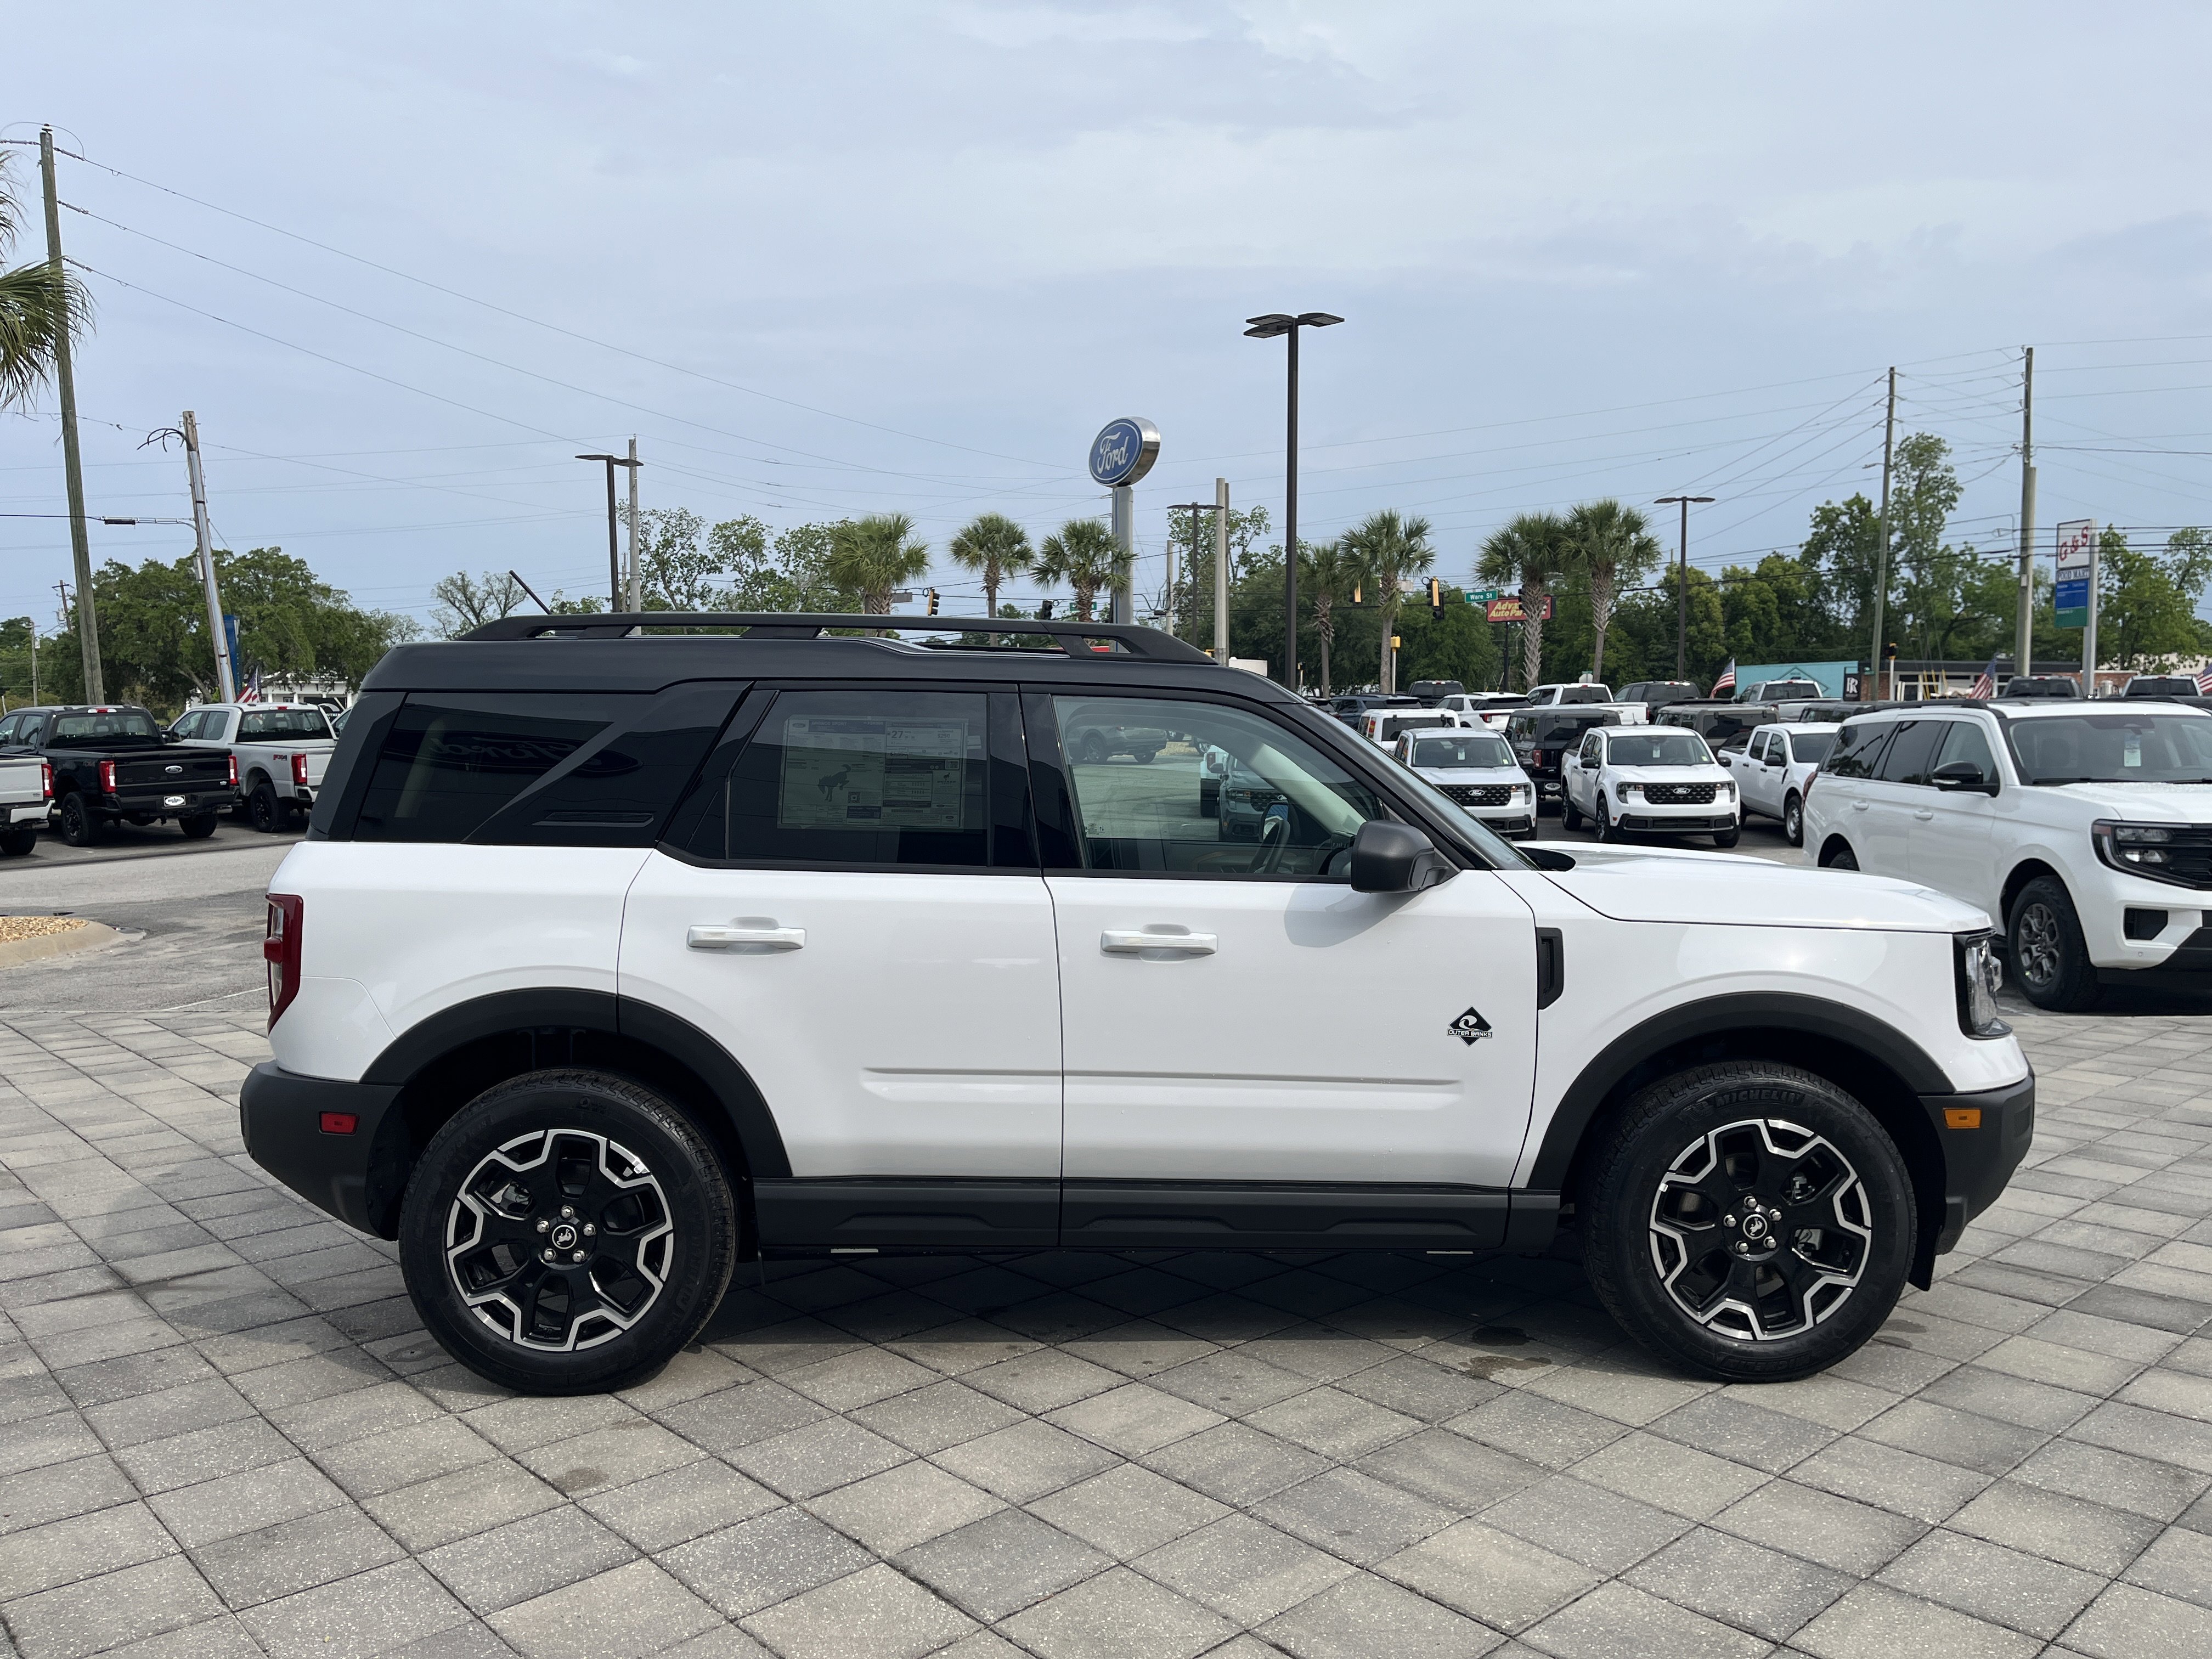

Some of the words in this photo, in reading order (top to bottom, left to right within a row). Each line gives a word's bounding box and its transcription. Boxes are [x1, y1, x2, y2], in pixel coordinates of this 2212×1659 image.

[1097, 432, 1130, 474] Ford
[2081, 526, 2089, 546] S
[2073, 568, 2089, 578] MART
[891, 730, 903, 738] 27
[1716, 1090, 1804, 1107] MICHELIN
